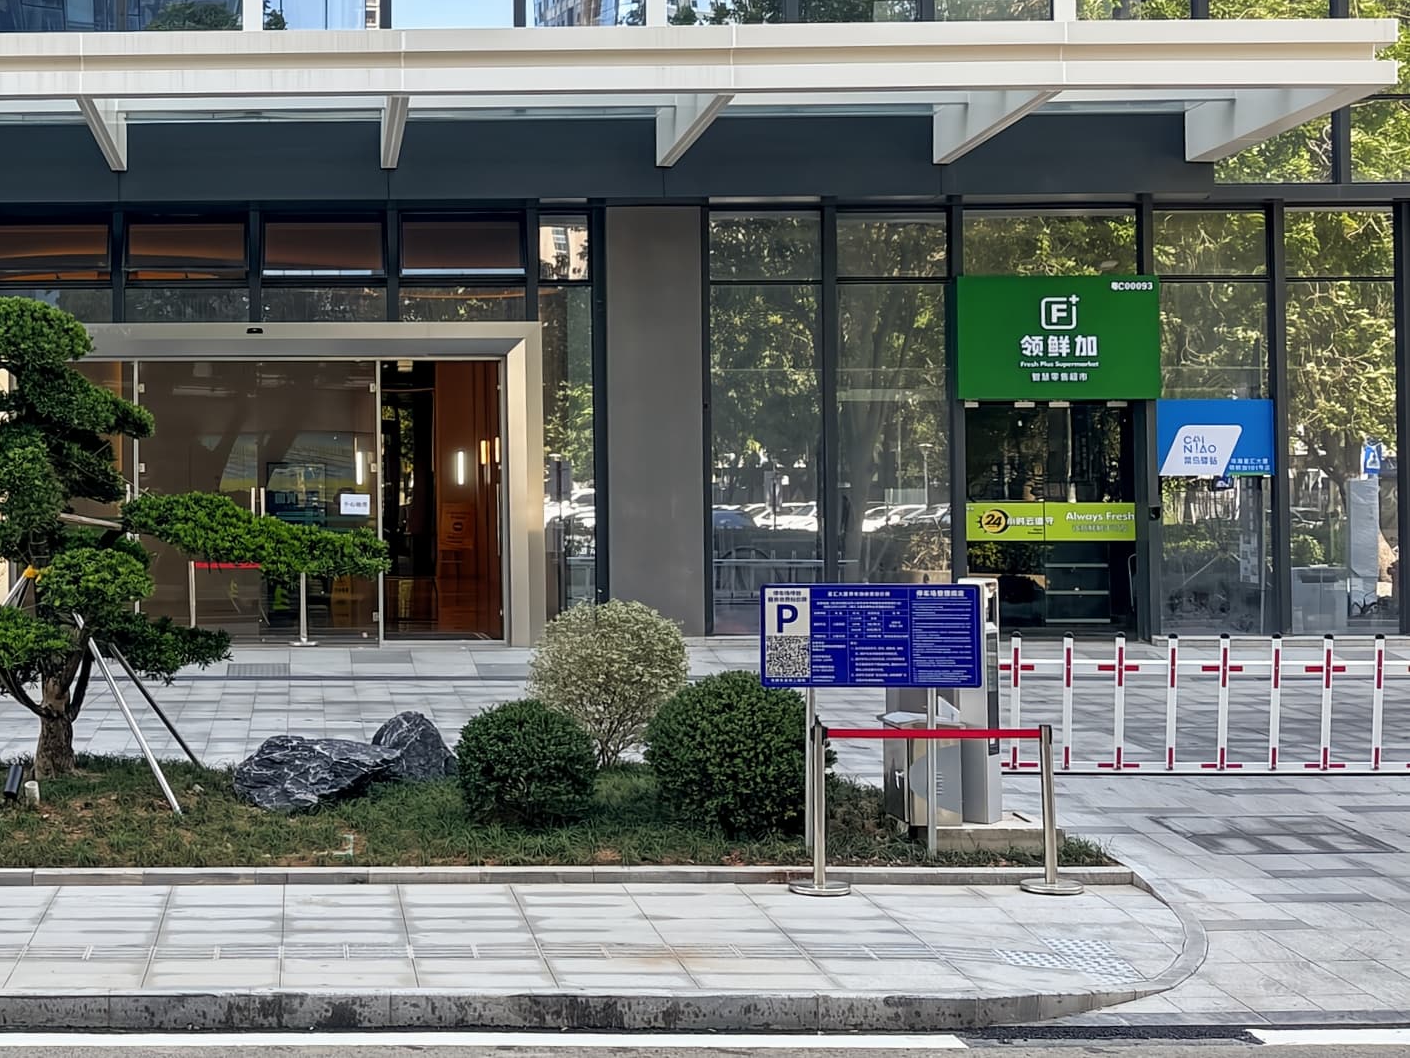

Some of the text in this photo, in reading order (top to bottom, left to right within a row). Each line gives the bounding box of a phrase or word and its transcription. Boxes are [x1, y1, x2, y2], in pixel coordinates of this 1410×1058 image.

[1019, 335, 1098, 358] 领鲜加
[1020, 360, 1039, 368] Fresh
[1055, 360, 1099, 369] Supermarket
[1065, 511, 1135, 522] Always Fresh
[776, 604, 799, 634] P
